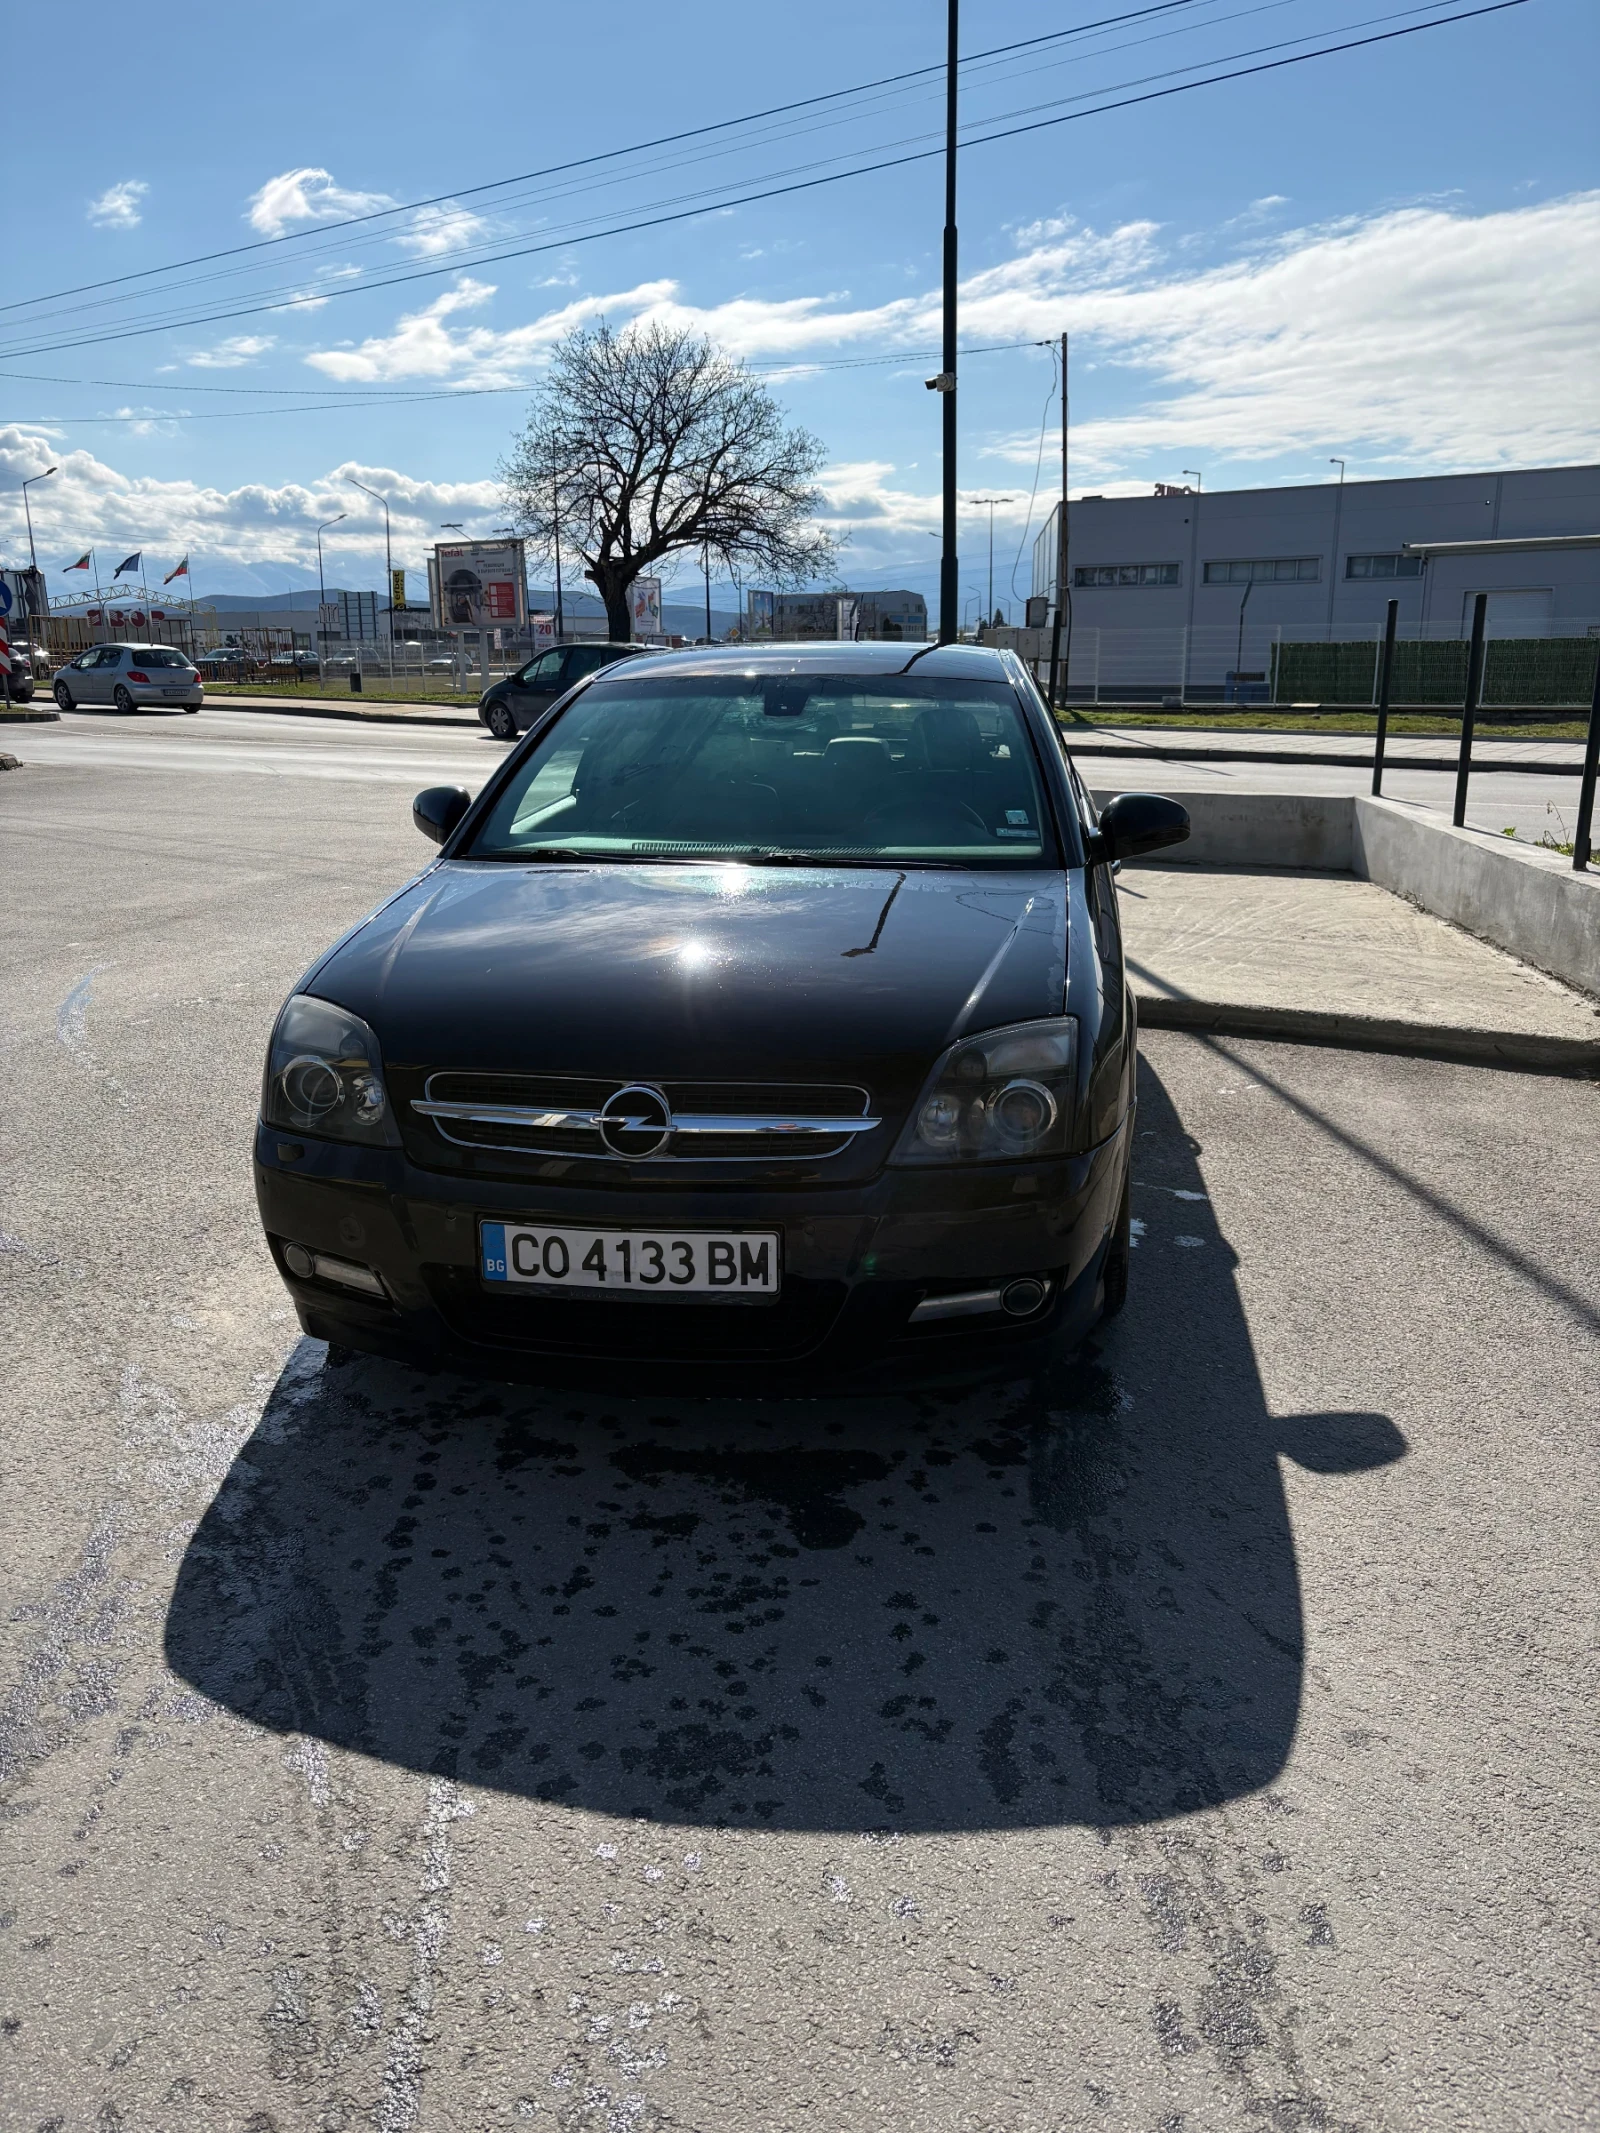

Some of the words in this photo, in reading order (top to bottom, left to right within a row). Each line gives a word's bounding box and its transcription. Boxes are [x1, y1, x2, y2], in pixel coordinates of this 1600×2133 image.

[440, 549, 464, 557] Tefal
[539, 624, 552, 635] 20
[512, 1233, 570, 1278] CO
[581, 1238, 696, 1285] 4133
[708, 1241, 769, 1286] BM
[486, 1259, 505, 1273] BG
